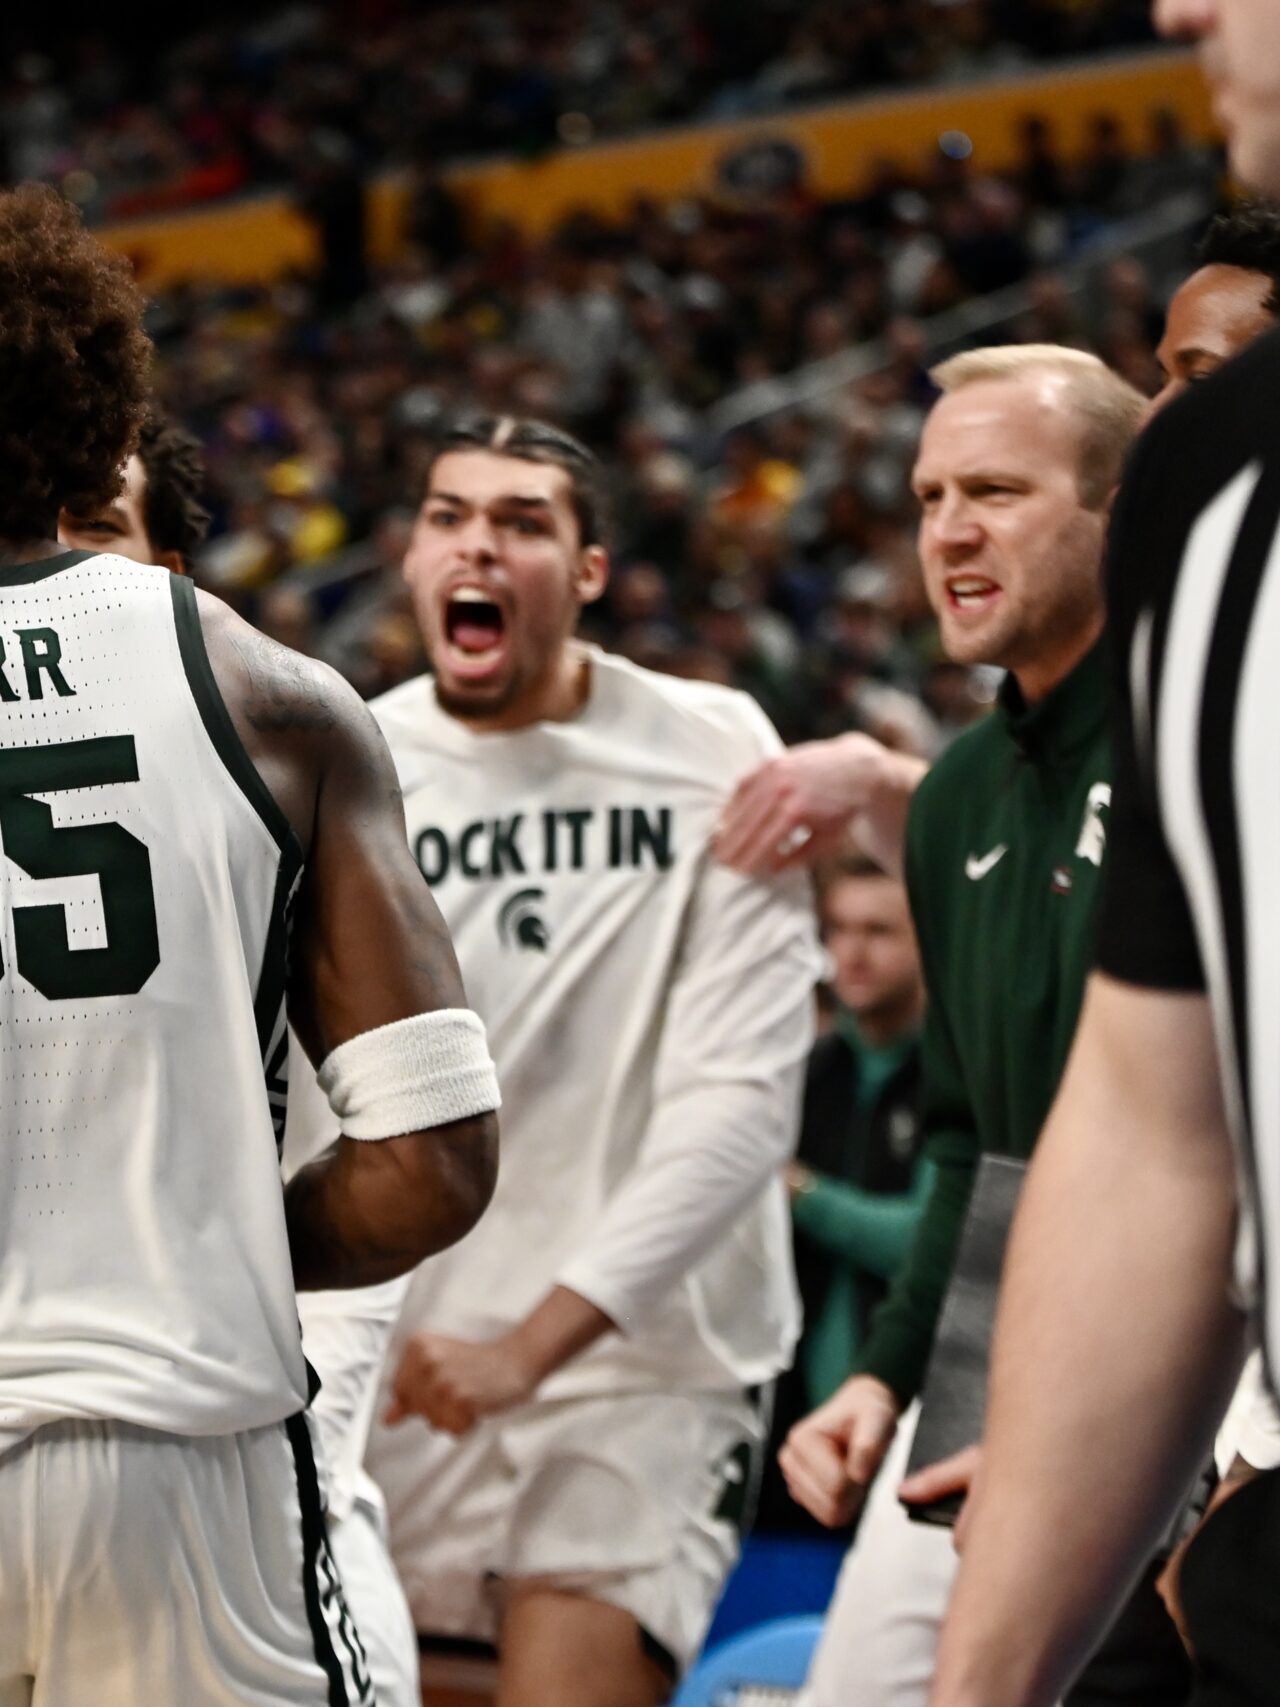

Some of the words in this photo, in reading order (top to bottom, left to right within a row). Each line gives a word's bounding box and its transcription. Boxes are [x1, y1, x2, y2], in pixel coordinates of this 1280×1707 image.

[415, 811, 526, 887] OCK
[542, 808, 593, 871] IT
[608, 807, 674, 871] IN
